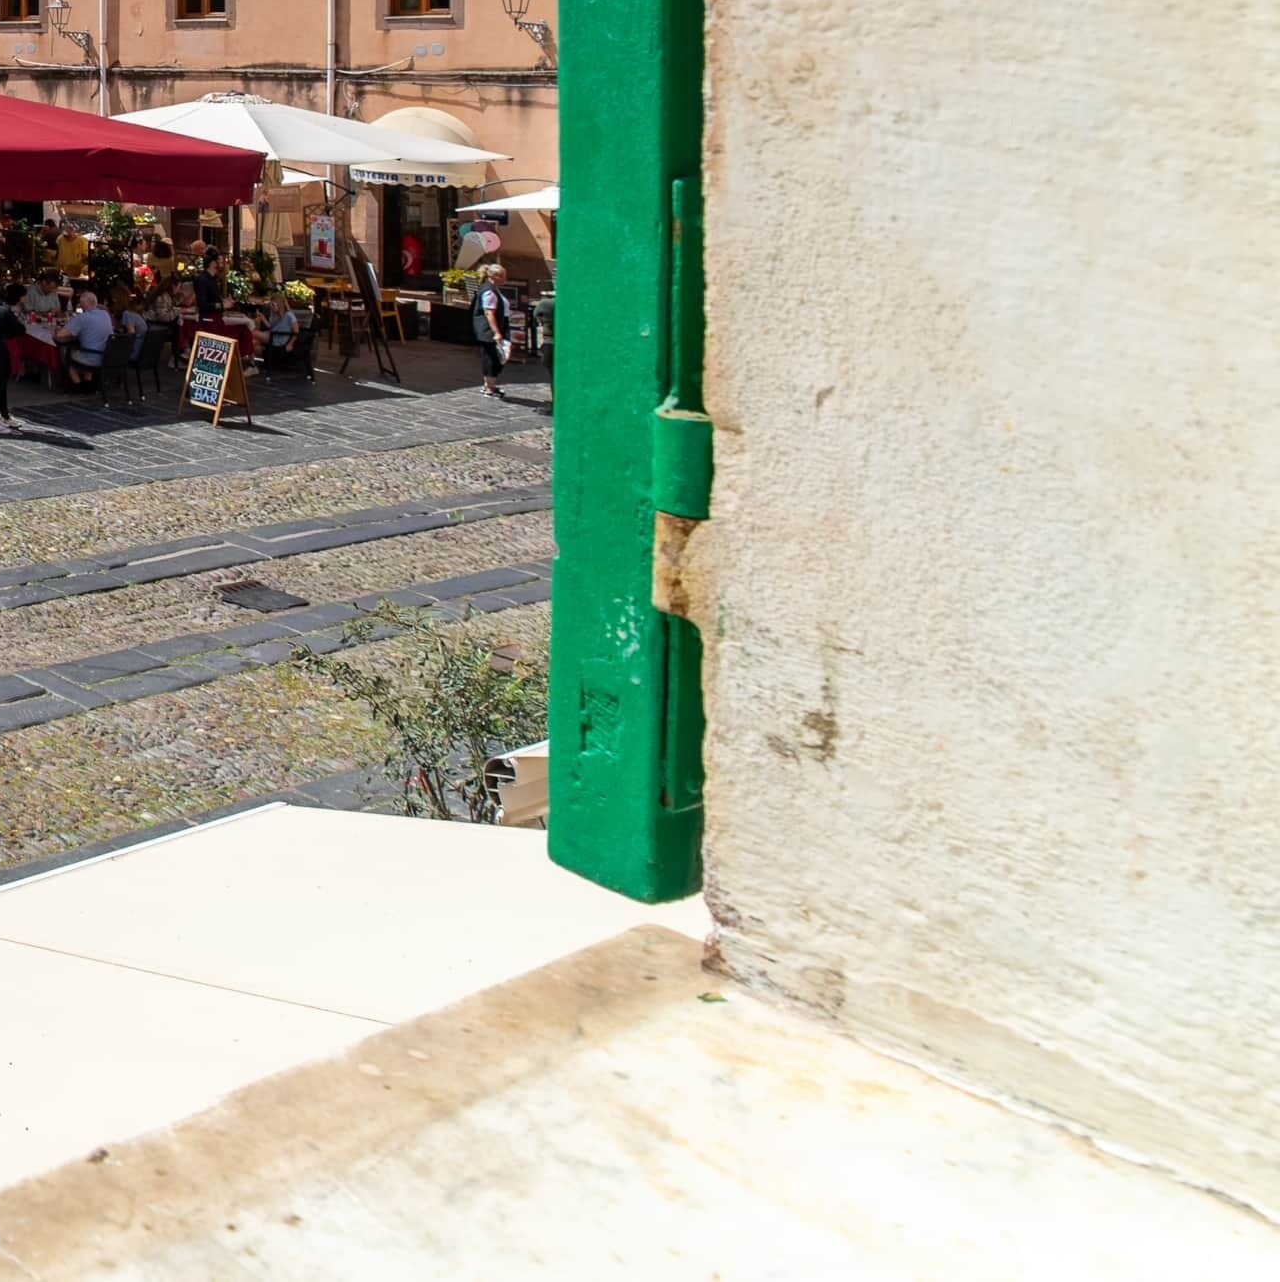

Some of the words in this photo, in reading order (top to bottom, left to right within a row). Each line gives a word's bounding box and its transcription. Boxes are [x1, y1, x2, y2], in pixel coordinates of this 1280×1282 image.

[415, 174, 447, 184] BAR
[197, 346, 227, 364] PIZZA
[195, 373, 219, 389] OPEN
[193, 388, 217, 404] BAR
